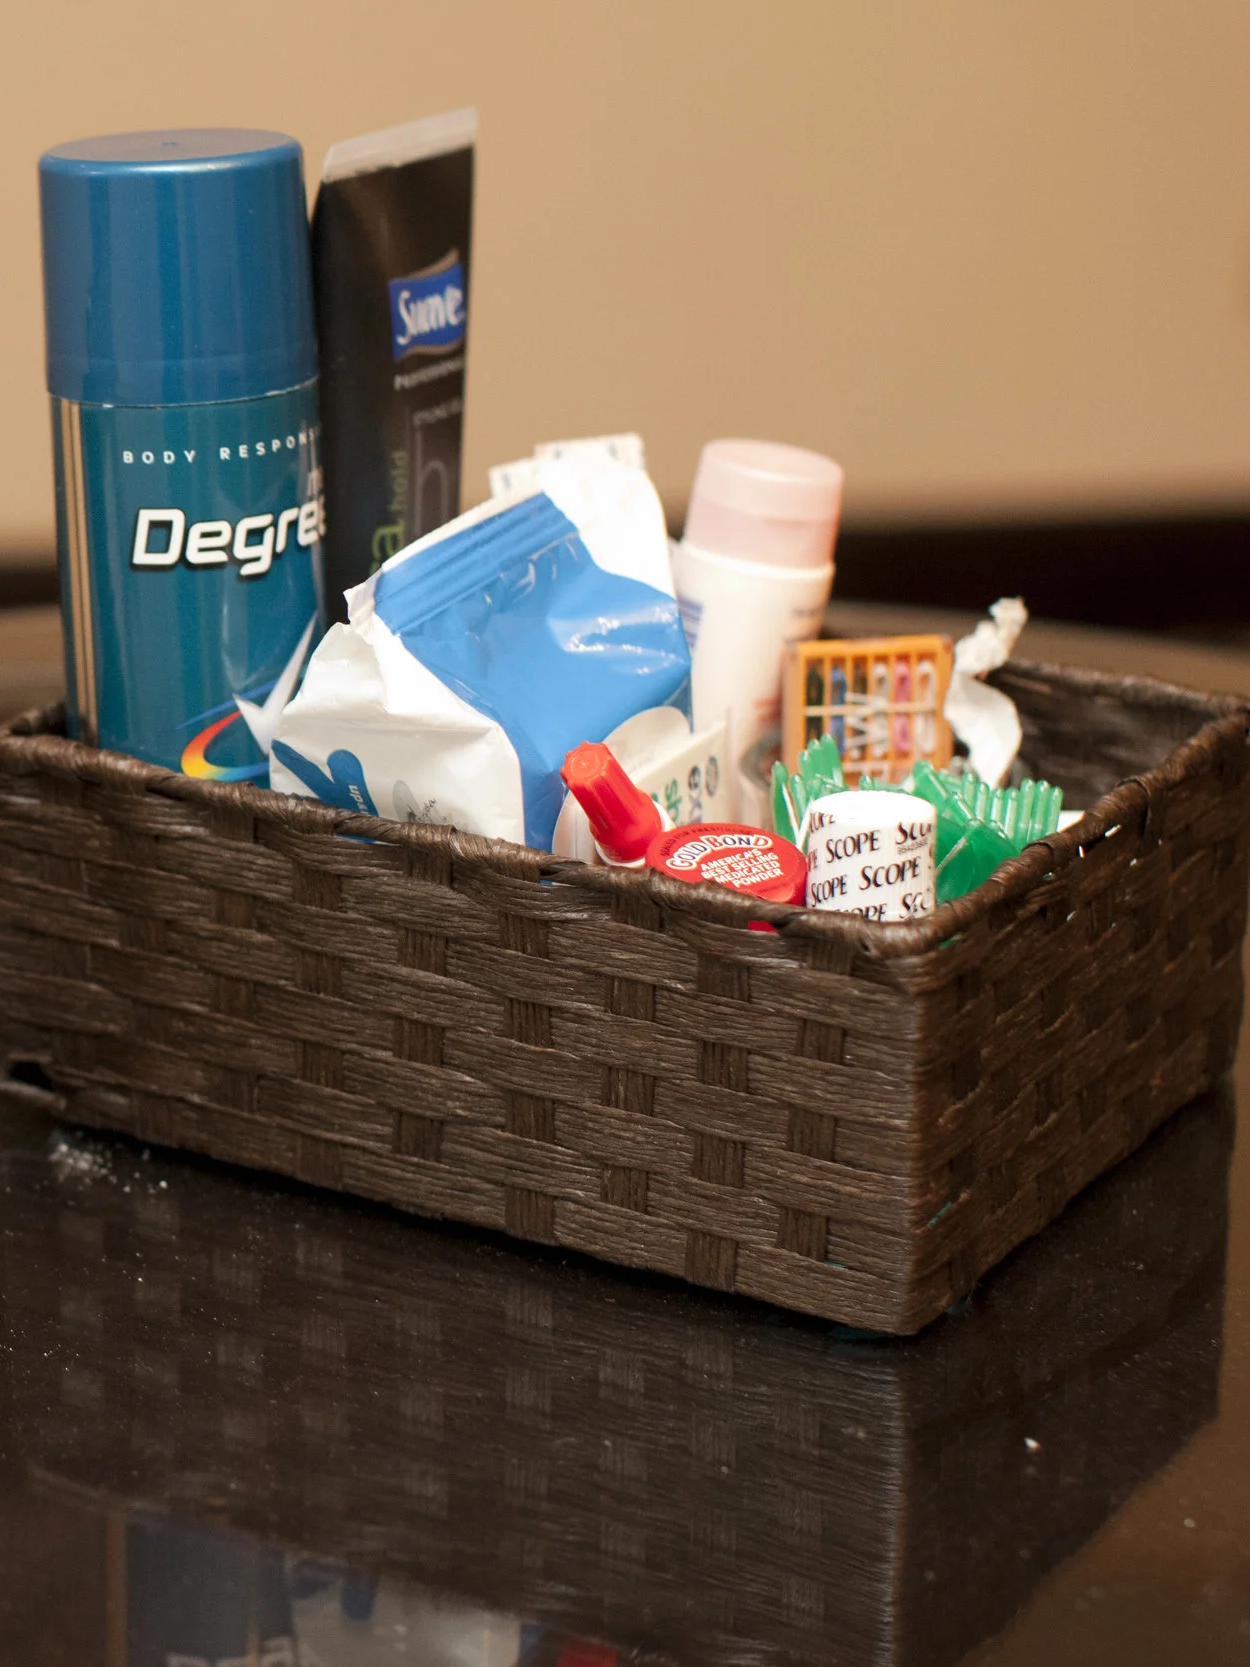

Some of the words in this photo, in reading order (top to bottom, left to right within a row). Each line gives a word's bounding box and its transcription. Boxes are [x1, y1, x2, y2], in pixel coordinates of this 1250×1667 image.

[123, 450, 196, 464] BODY
[666, 841, 711, 870] GOLD
[701, 834, 773, 850] BOND
[825, 829, 880, 863] SCOPE
[701, 849, 762, 870] AMERICA'S
[701, 865, 731, 879] BEST
[732, 853, 779, 872] SELLING
[714, 861, 781, 884] MEDICATED
[732, 869, 784, 888] POWDER
[811, 874, 847, 908] SCOPE
[859, 856, 921, 891] SCOPE
